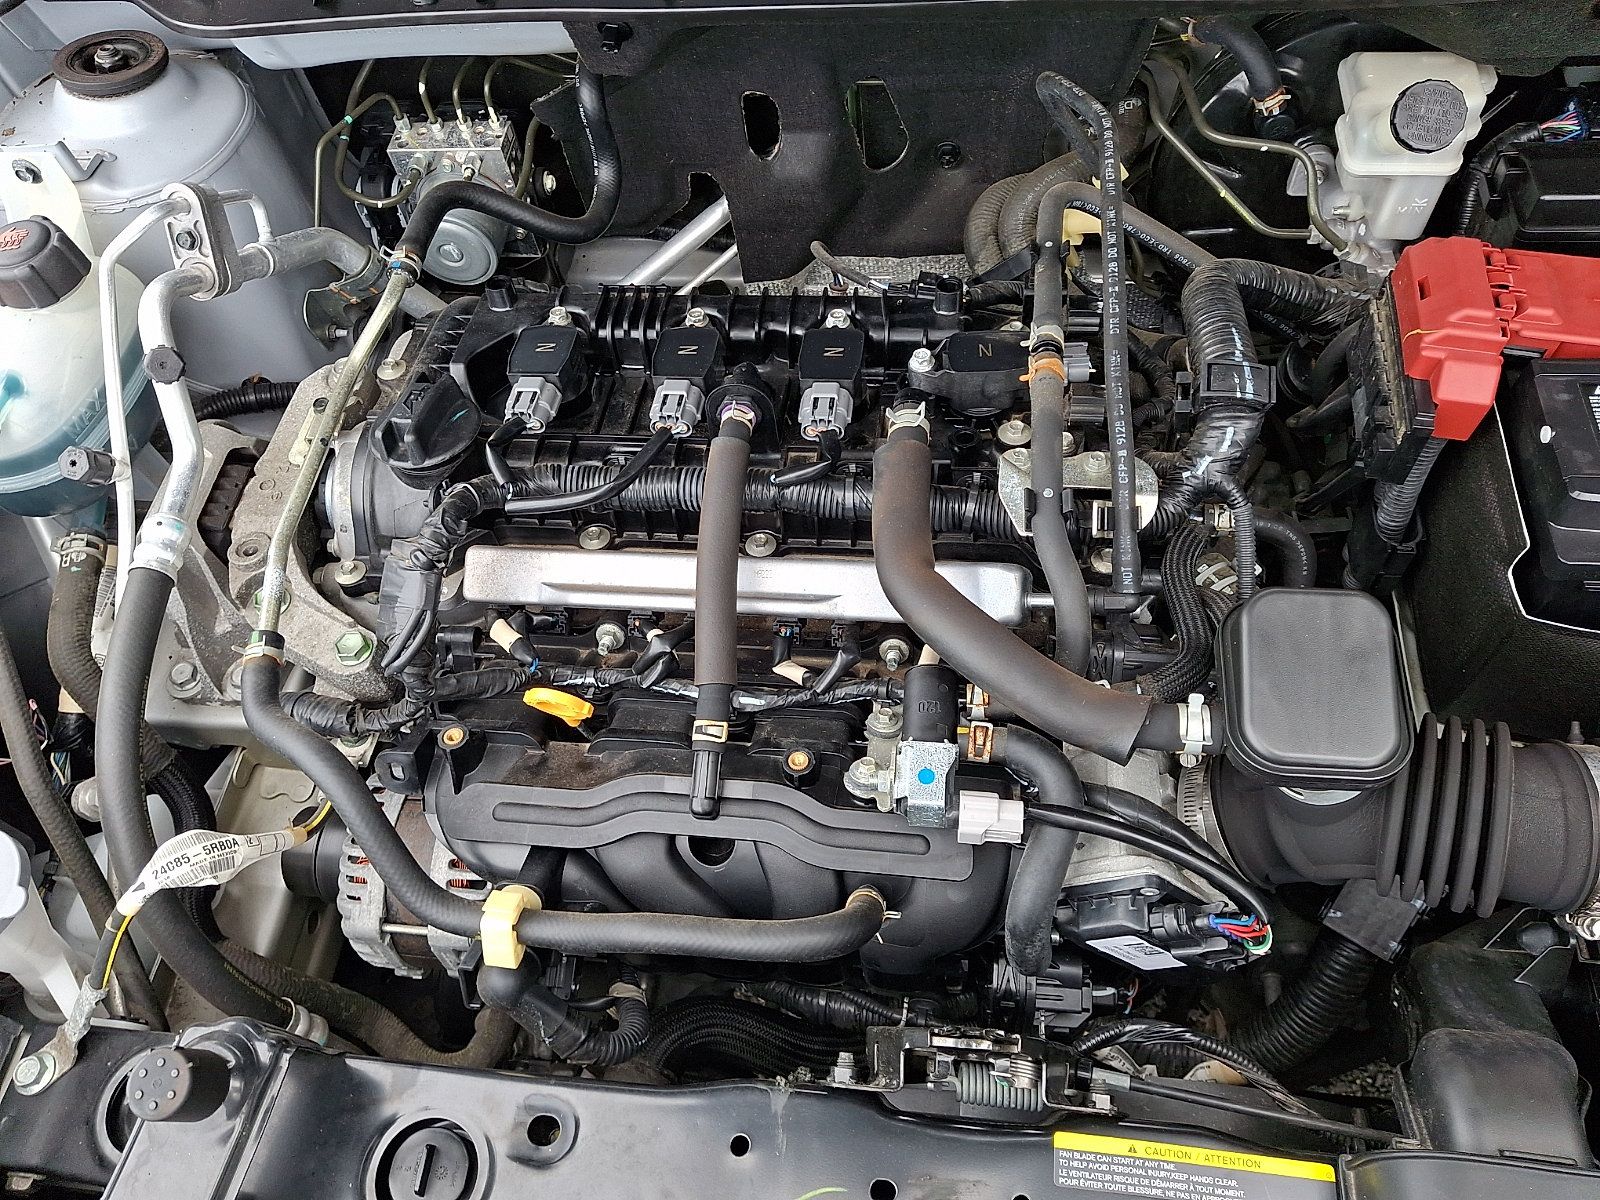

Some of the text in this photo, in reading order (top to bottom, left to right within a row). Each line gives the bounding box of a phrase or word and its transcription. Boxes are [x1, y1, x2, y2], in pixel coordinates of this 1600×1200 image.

[1107, 231, 1117, 245] NOT
[1107, 247, 1118, 258] DO
[1109, 317, 1120, 335] DTR
[978, 343, 993, 357] N
[1121, 566, 1134, 585] NOT
[1059, 1150, 1072, 1158] FAN
[1073, 1152, 1096, 1161] BLADE
[1096, 1154, 1112, 1162] CAN
[1112, 1156, 1135, 1165] START
[1144, 1160, 1159, 1168] ANY
[1159, 1162, 1177, 1171] TIME.
[1144, 1146, 1192, 1160] CAUTION
[1204, 1154, 1261, 1169] ATTENTION
[1059, 1169, 1246, 1198] LE VENTILATEUR RISQUE DE DÉMARRER À TOUT MOMENT.
[1069, 1160, 1088, 1168] HELP
[1088, 1162, 1110, 1171] AVOID
[1110, 1165, 1147, 1176] PERSONAL
[1190, 1174, 1214, 1184] HANDS
[1214, 1177, 1239, 1187] CLEAR.
[1059, 1177, 1079, 1187] POUR
[1079, 1178, 1103, 1189] ÉVITER
[1103, 1182, 1126, 1192] TOUTE
[1127, 1185, 1165, 1198] BLESSURE,
[1165, 1189, 1176, 1198] NE
[1176, 1192, 1190, 1200] PAS
